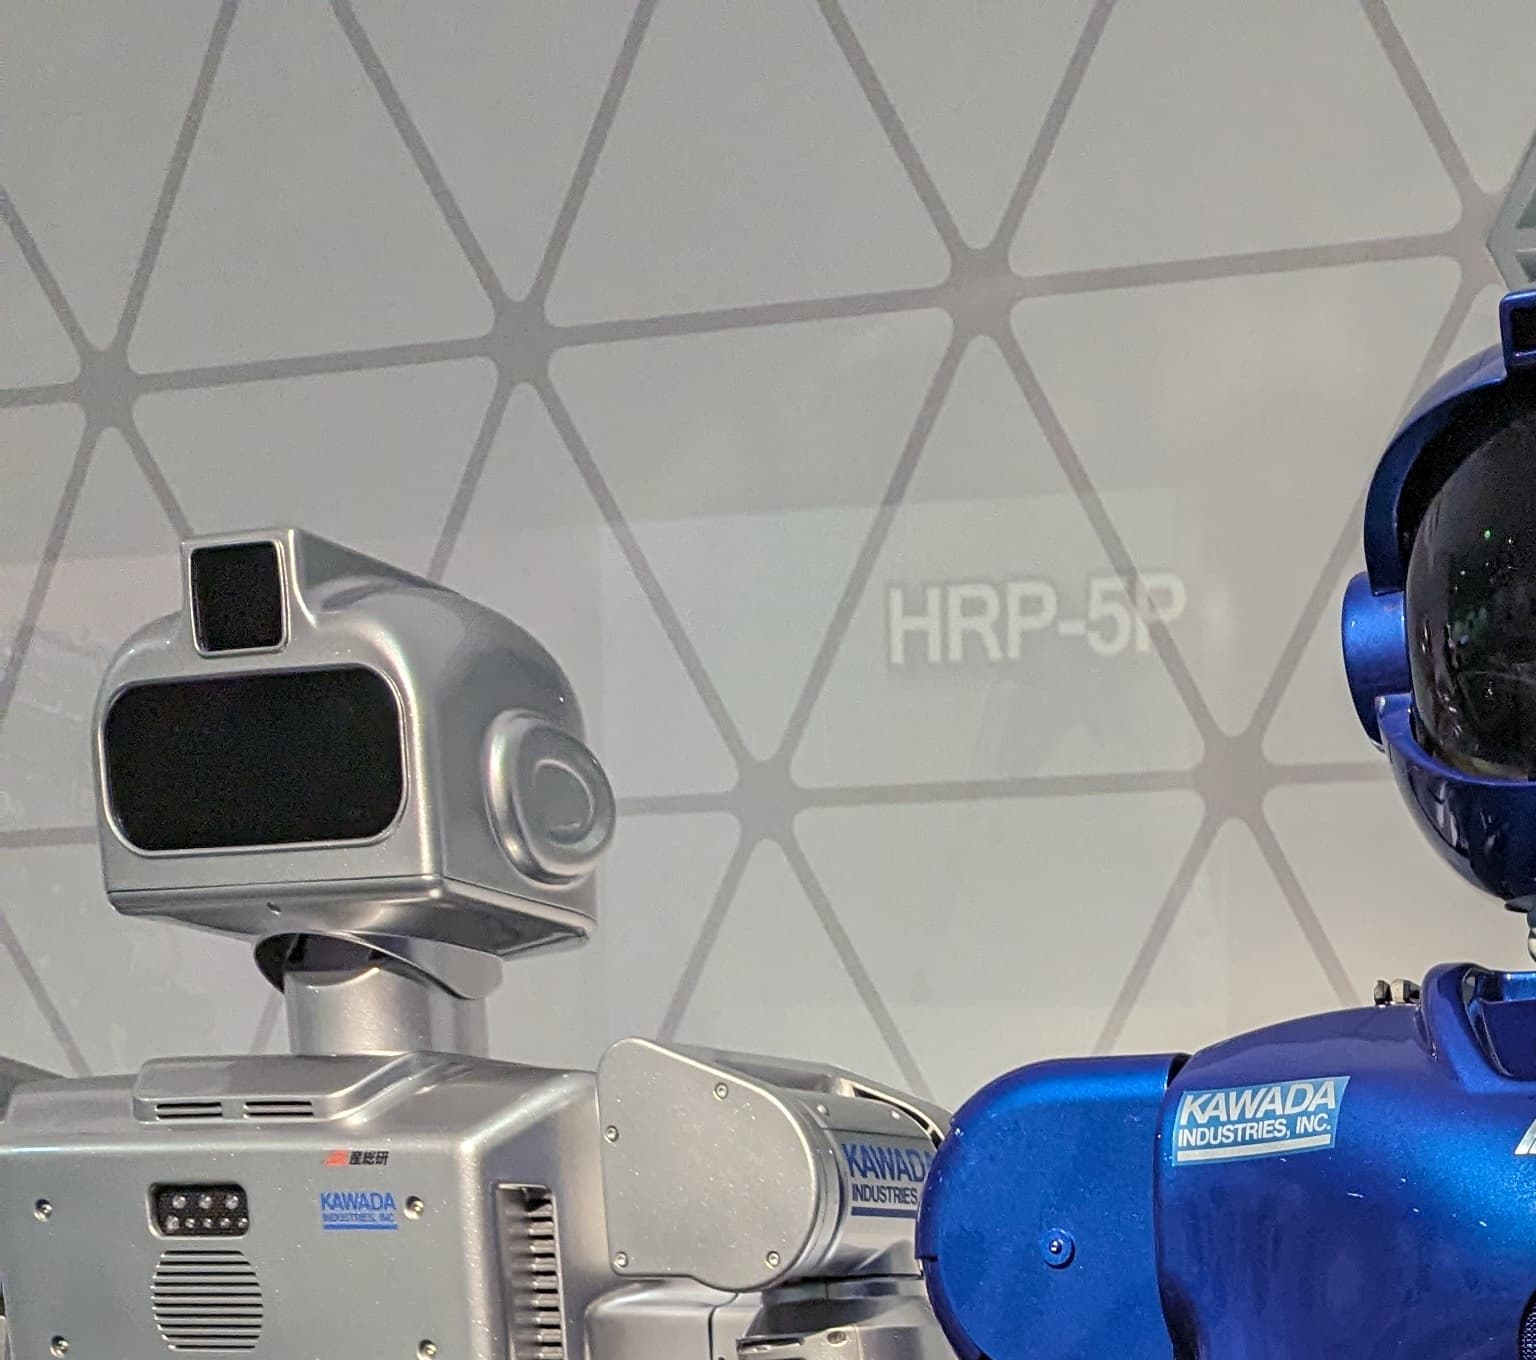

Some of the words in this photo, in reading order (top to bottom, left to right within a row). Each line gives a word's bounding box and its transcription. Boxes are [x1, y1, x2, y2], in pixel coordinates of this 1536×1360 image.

[889, 572, 1187, 664] HRP-5P
[1180, 1080, 1336, 1125] KAWADA
[1177, 1118, 1291, 1147] INDUSTRIES,
[1296, 1112, 1332, 1135] INC.
[320, 1191, 396, 1210] KAWADA
